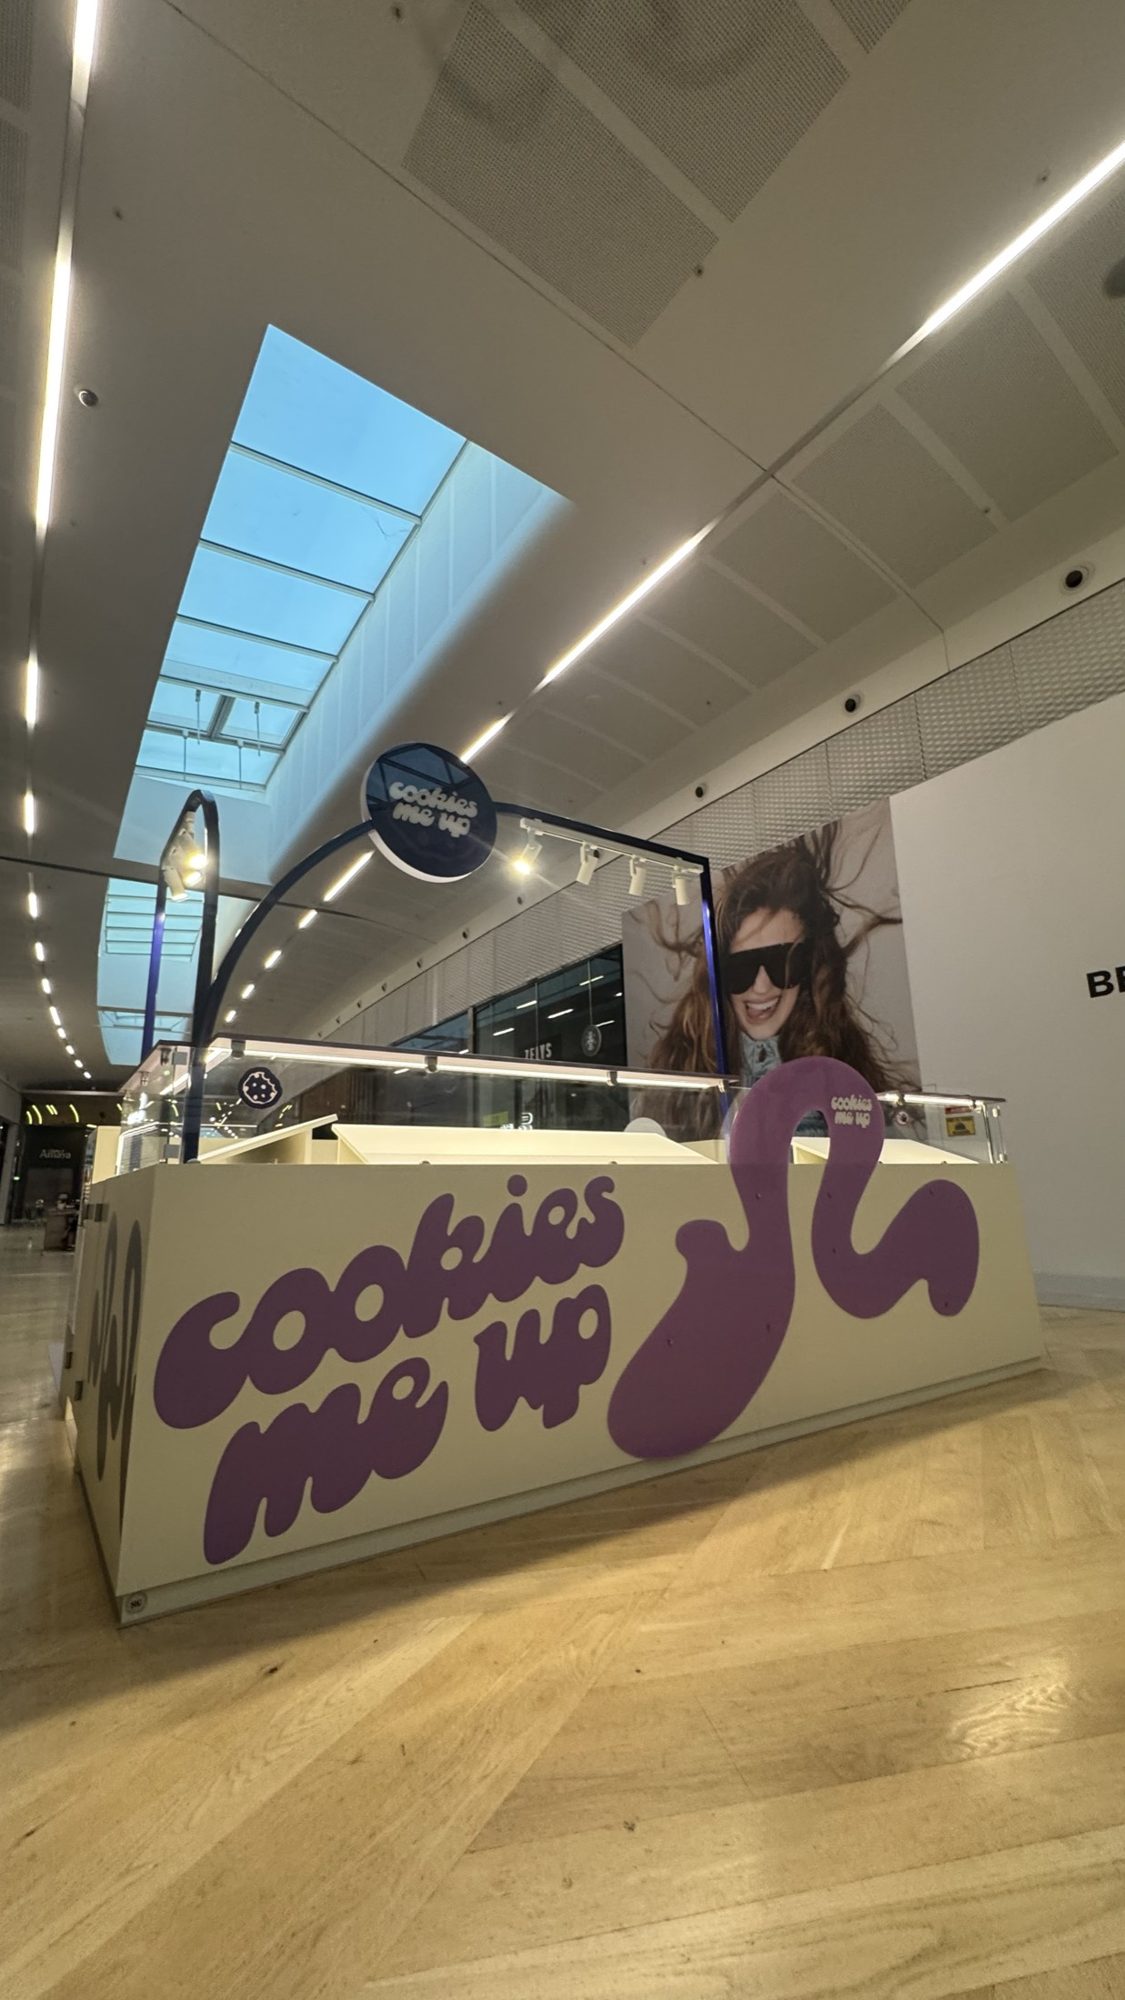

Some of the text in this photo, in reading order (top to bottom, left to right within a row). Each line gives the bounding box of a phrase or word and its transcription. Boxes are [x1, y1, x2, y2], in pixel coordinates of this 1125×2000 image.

[389, 781, 478, 818] cookies
[393, 802, 471, 838] me up
[831, 1094, 873, 1111] cookies
[834, 1111, 871, 1128] me up
[153, 1175, 625, 1429] cookies
[203, 1357, 449, 1565] me
[473, 1284, 612, 1431] up
